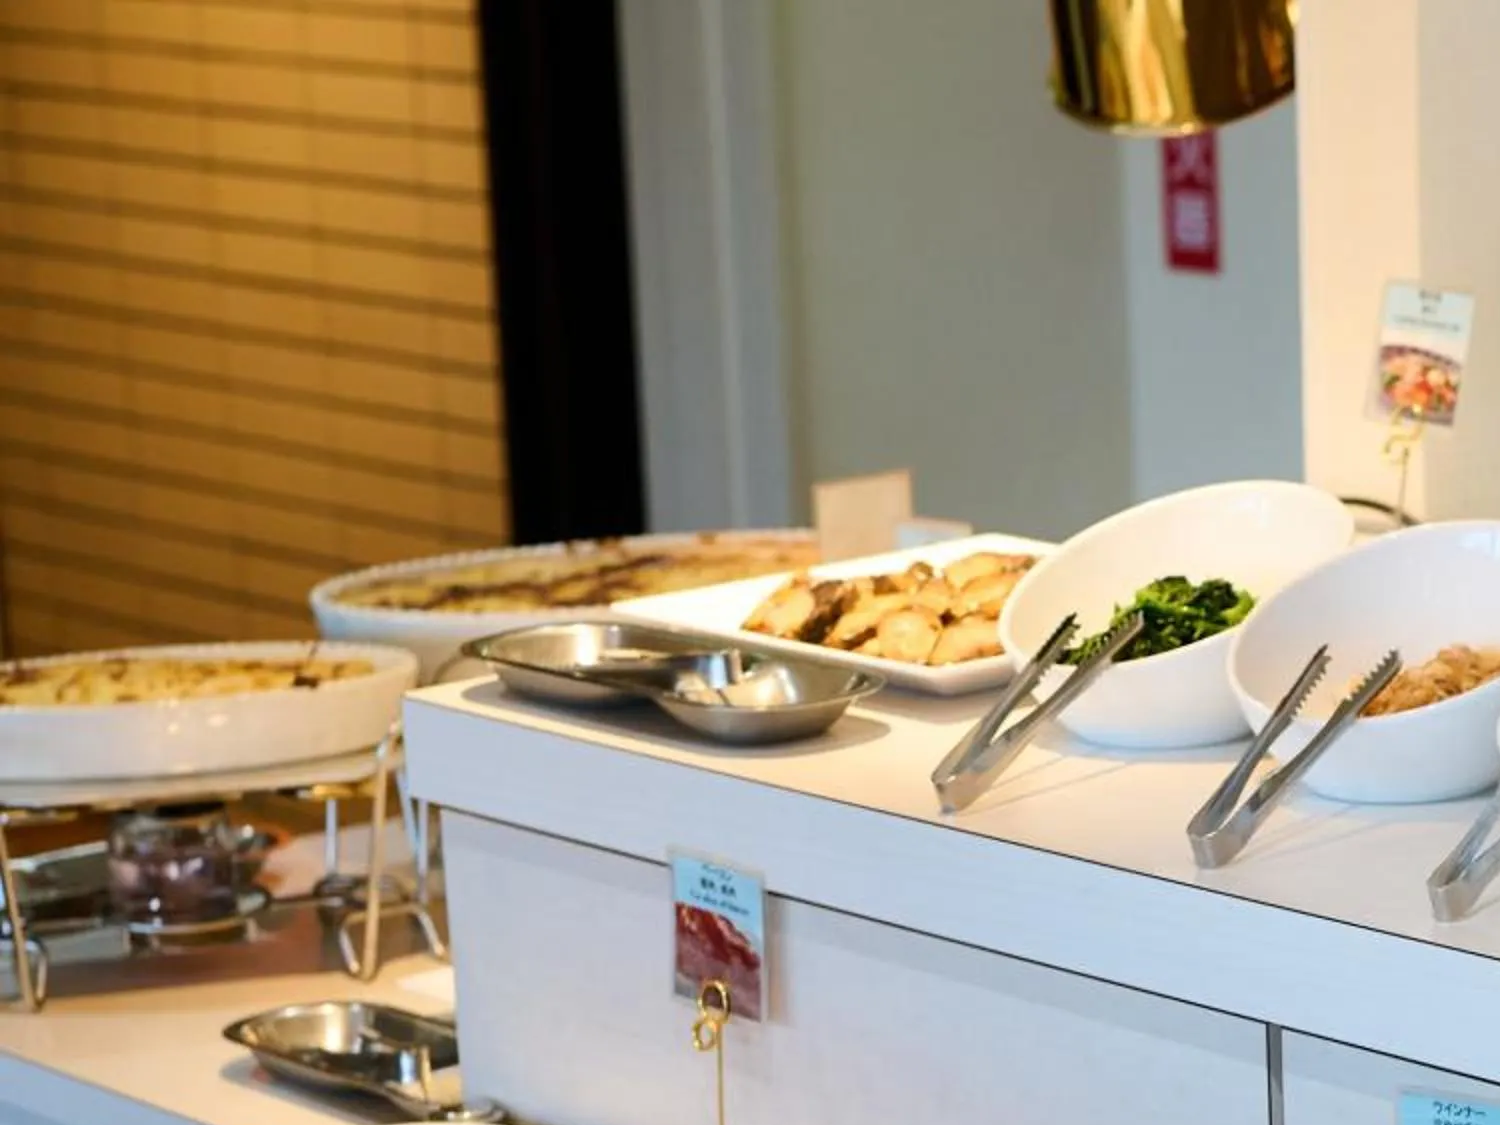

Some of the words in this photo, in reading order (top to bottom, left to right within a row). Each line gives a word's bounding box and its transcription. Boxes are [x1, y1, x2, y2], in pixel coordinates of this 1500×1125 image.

[1432, 1100, 1487, 1117] ウインナー
